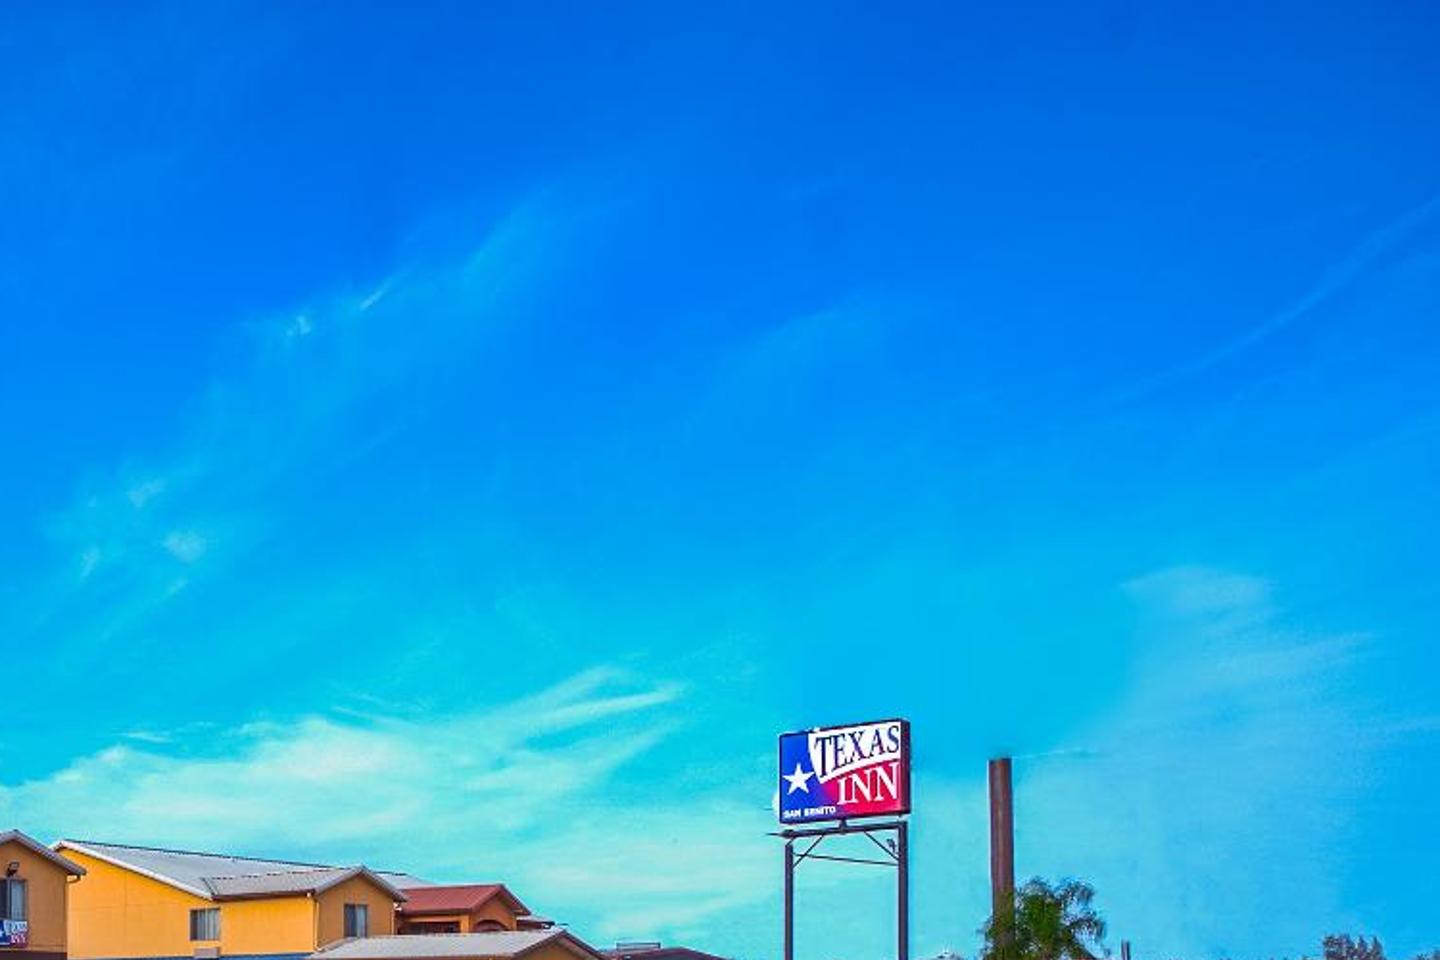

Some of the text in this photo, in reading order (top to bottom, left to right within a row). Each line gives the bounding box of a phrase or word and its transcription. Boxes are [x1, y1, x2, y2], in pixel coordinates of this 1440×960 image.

[814, 725, 900, 778] TEXAS
[837, 763, 900, 805] INN
[783, 808, 801, 819] SAN
